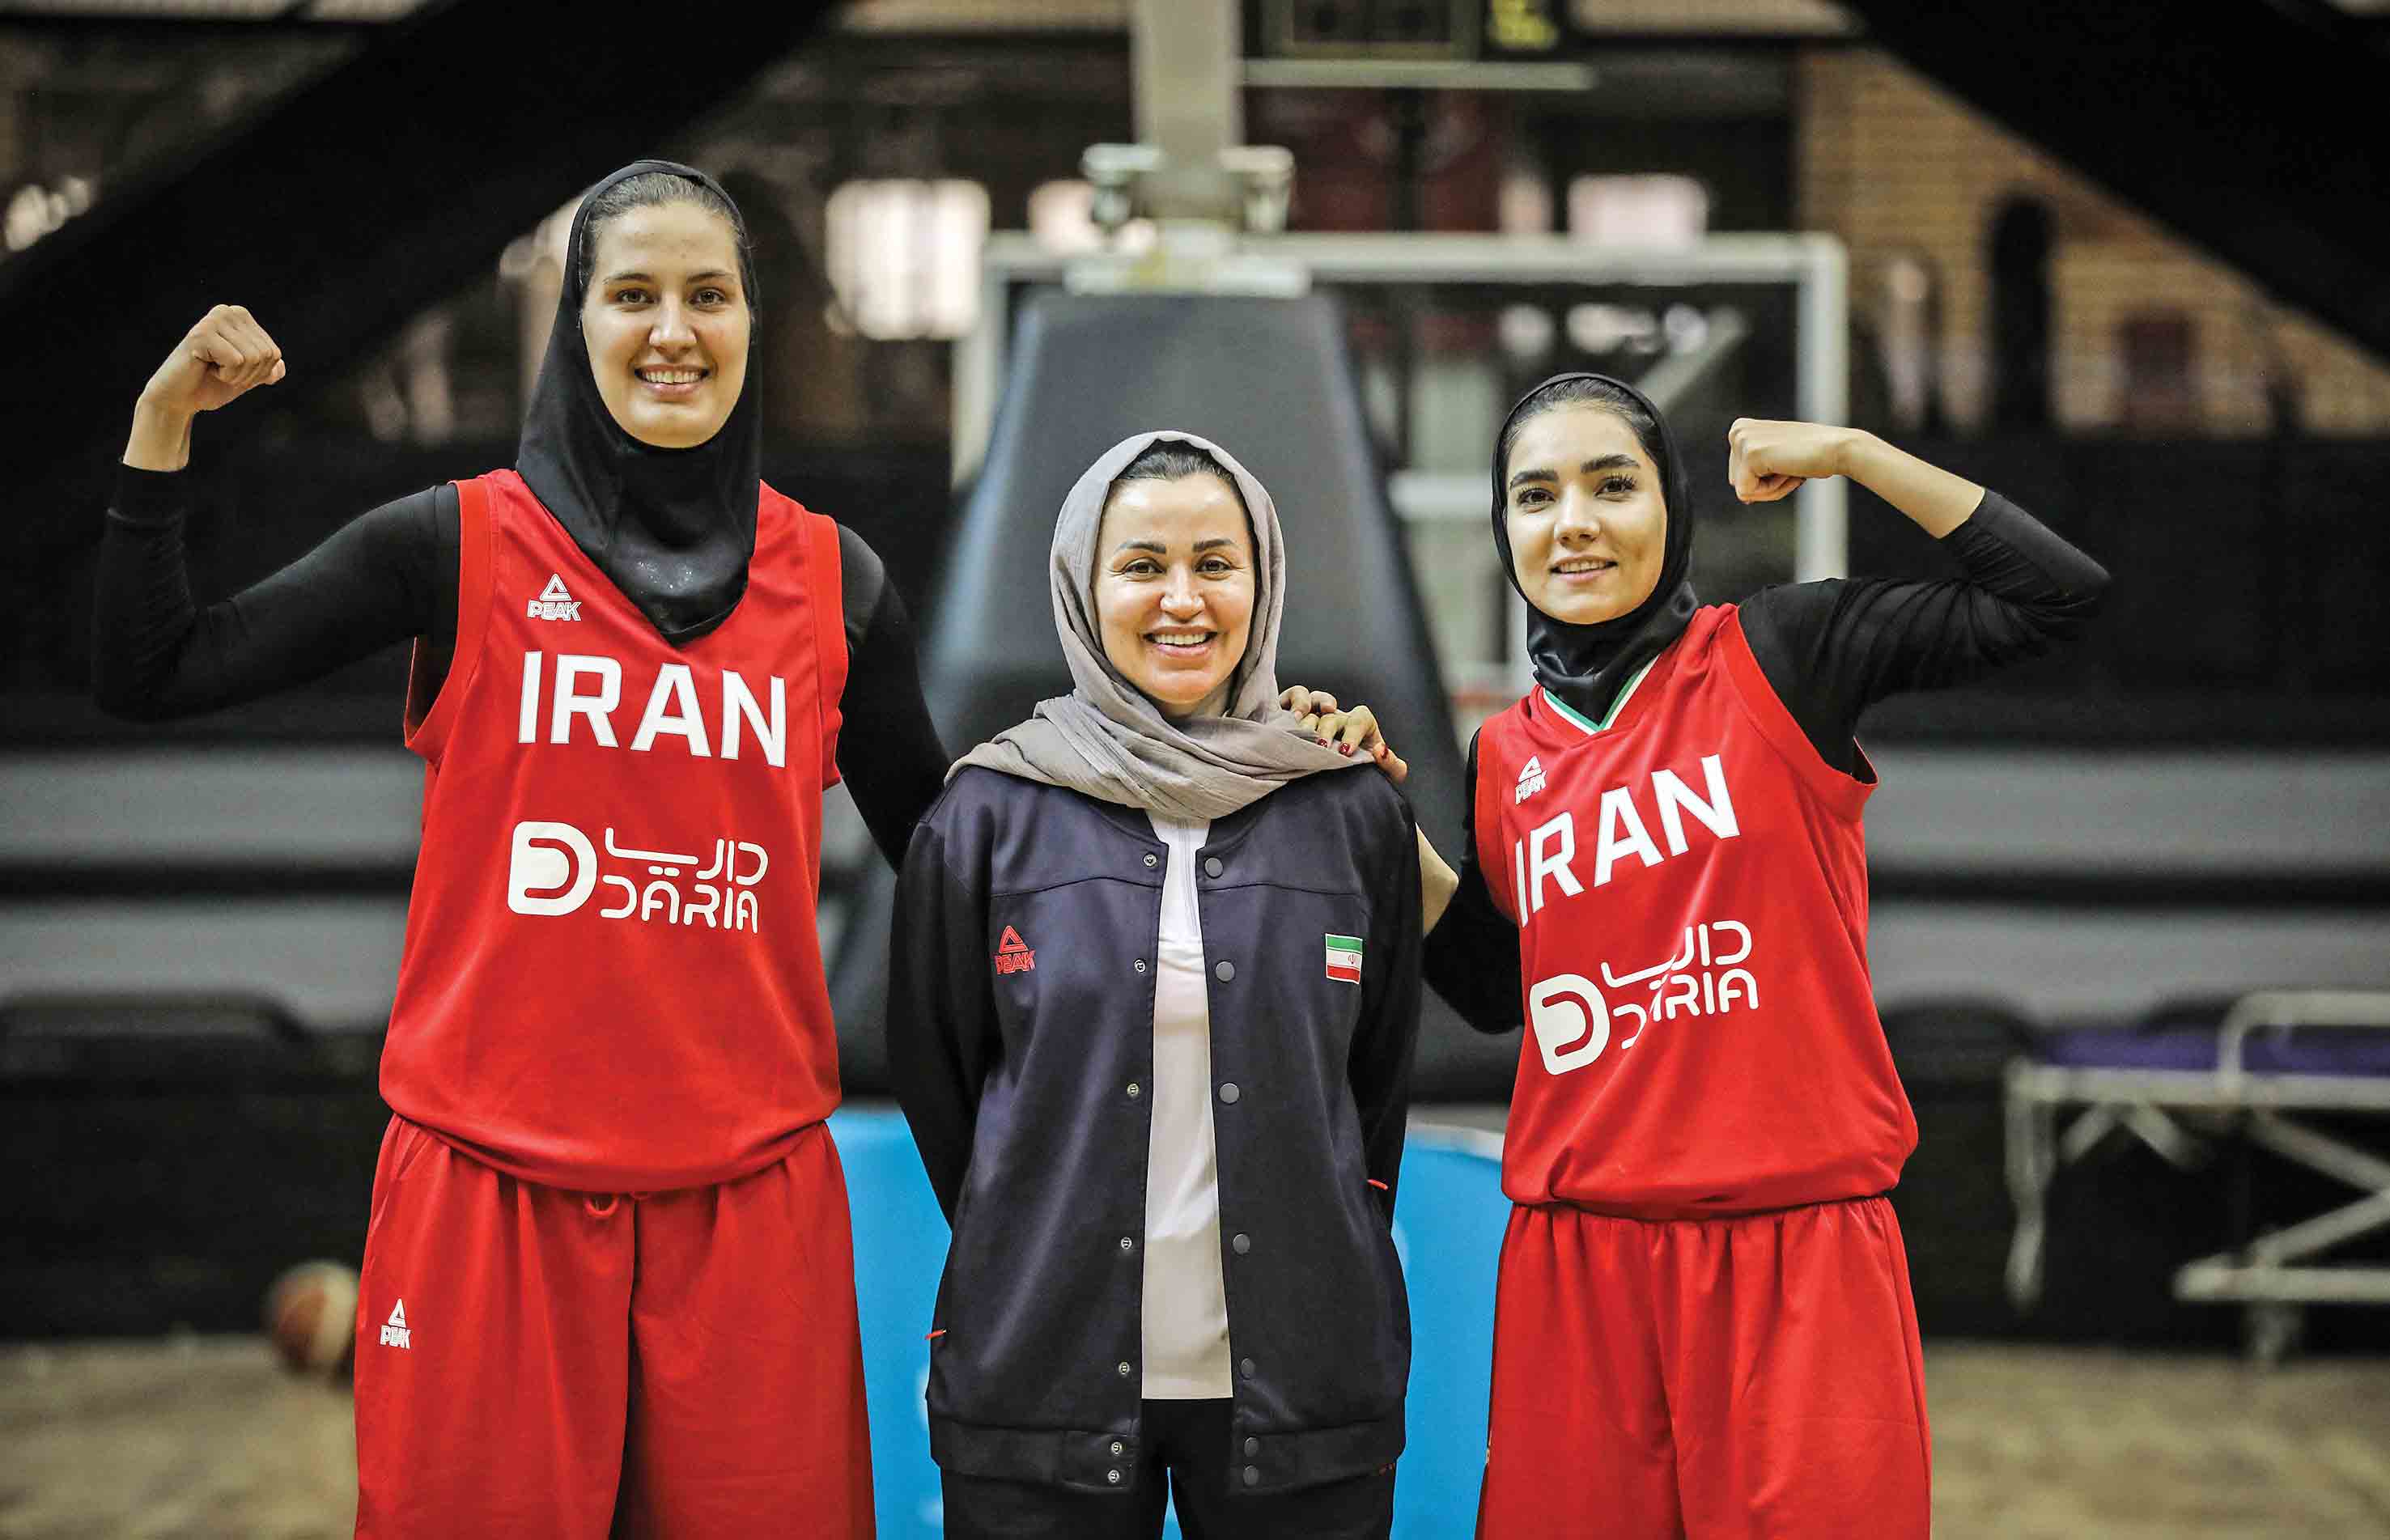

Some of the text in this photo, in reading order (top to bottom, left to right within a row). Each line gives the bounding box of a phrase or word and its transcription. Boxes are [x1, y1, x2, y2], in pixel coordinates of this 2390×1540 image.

[527, 600, 582, 622] PEAK
[518, 651, 787, 768] IRAN
[1515, 753, 1741, 928] IRAN
[600, 874, 758, 934] DARIA
[995, 949, 1036, 975] PEAK
